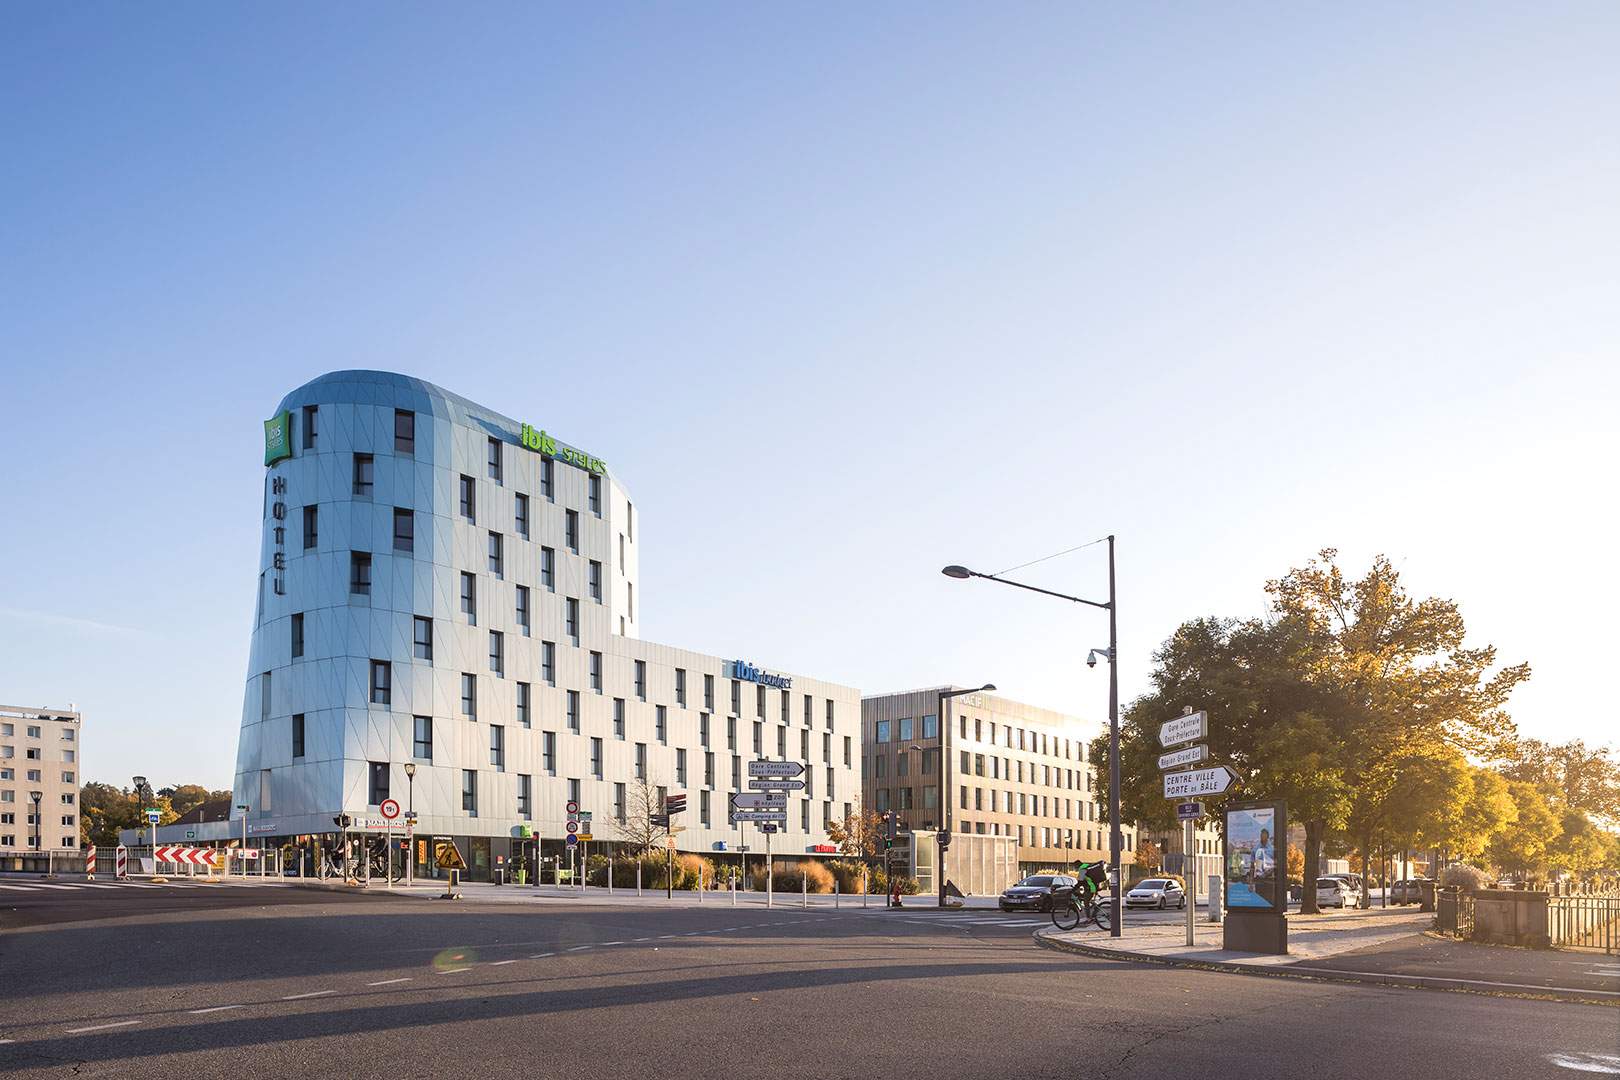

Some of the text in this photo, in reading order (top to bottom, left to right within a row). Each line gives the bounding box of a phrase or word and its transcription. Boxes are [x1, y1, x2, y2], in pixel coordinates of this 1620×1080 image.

[268, 424, 281, 441] ibis
[521, 422, 557, 456] ibis
[273, 476, 287, 596] HOTEL
[736, 659, 760, 682] ibis
[960, 694, 982, 707] MACIF
[1166, 771, 1215, 786] CENTRE VILLE
[1166, 785, 1188, 795] PORTE
[1200, 781, 1218, 791] BÂLE
